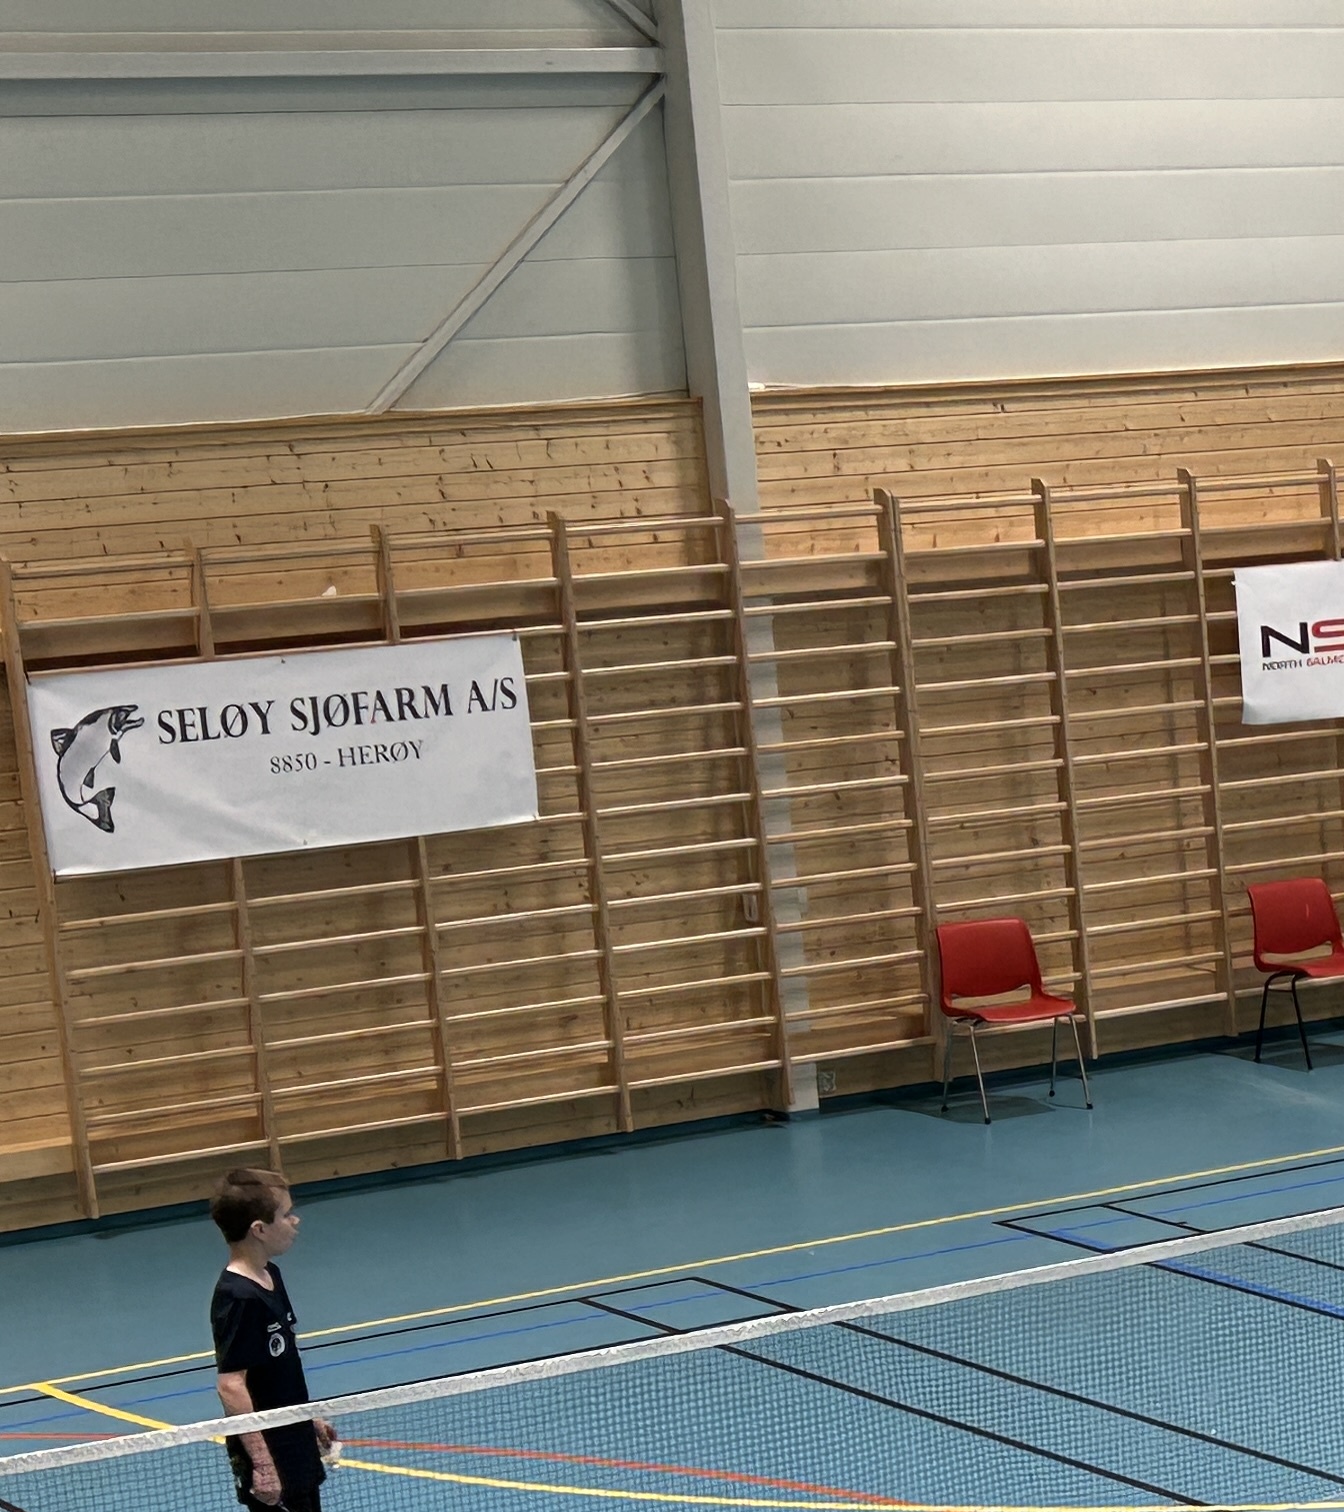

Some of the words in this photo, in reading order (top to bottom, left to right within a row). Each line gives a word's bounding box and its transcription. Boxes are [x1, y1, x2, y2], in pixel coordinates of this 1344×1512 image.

[157, 699, 276, 745] SELØY
[290, 683, 455, 734] SJØFARM
[466, 676, 518, 716] A/S
[269, 752, 318, 775] 8850
[337, 739, 425, 768] HERØY
